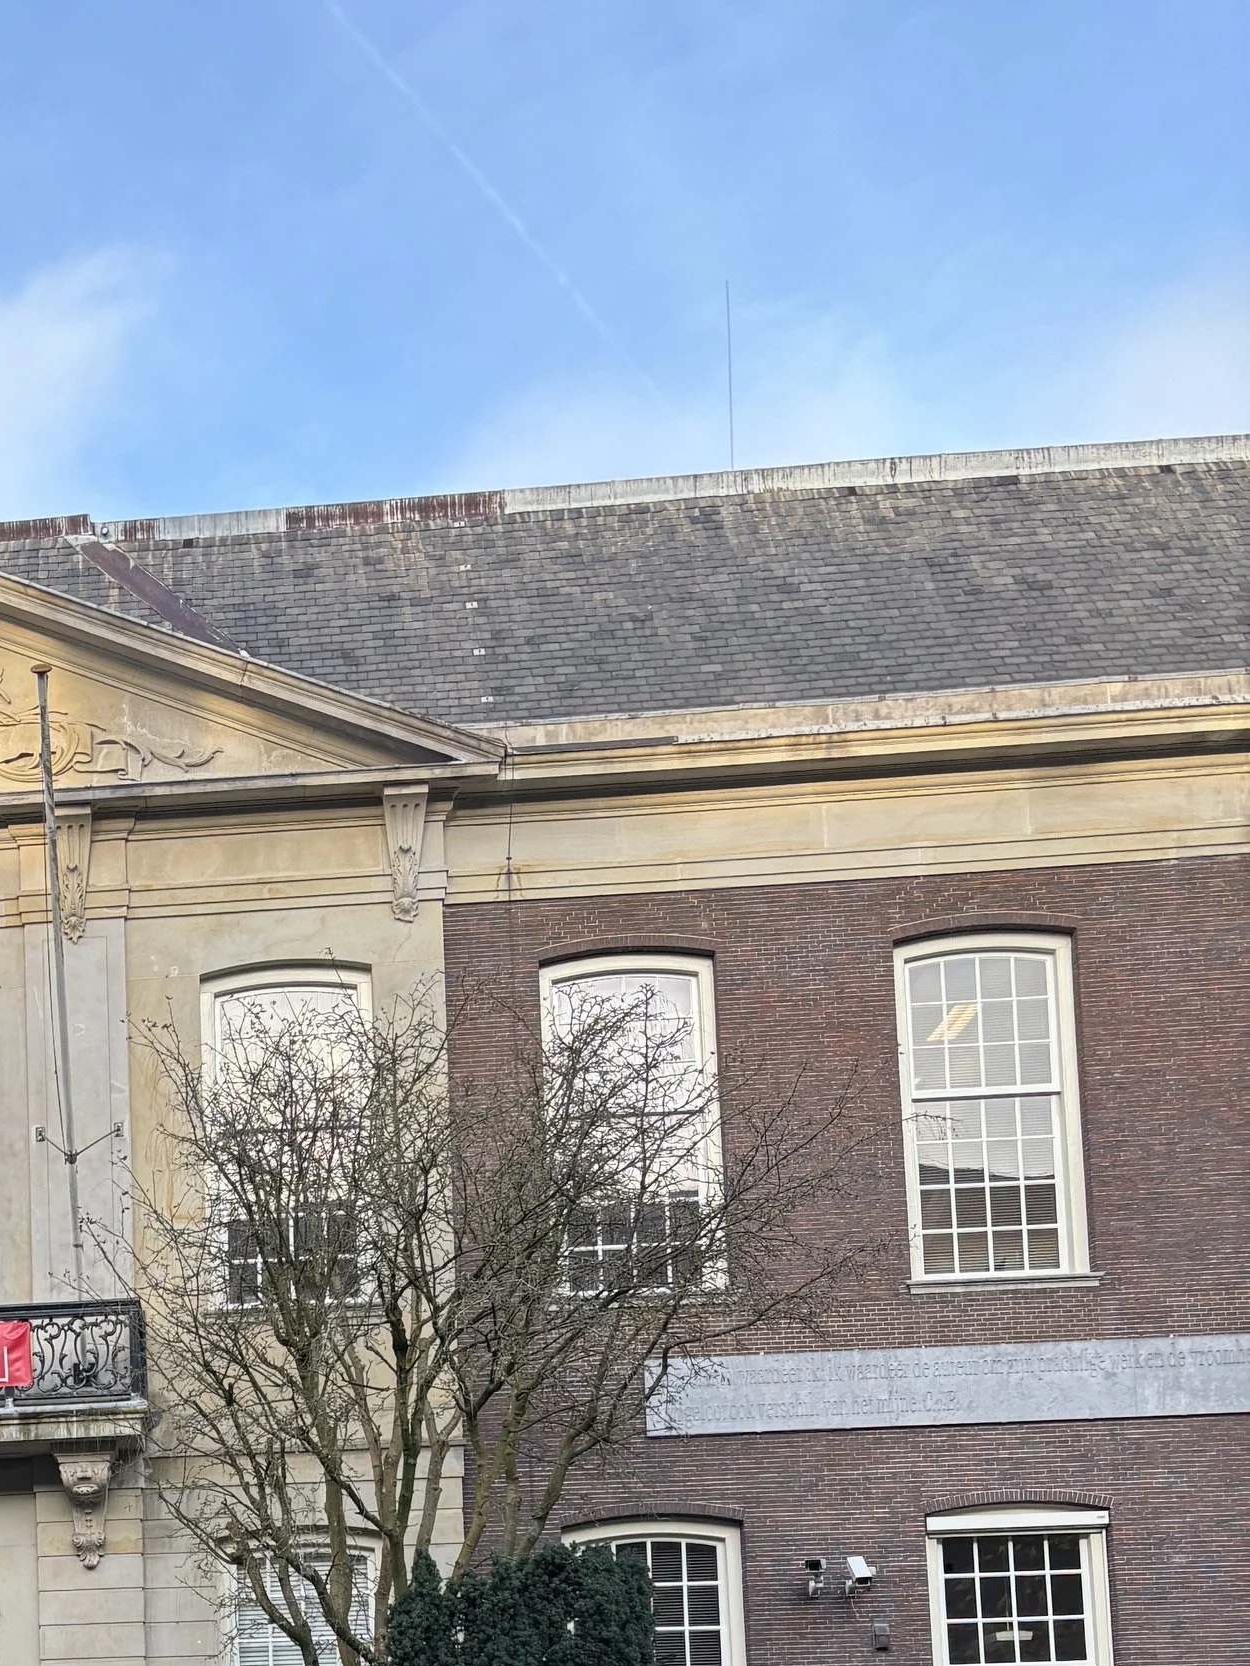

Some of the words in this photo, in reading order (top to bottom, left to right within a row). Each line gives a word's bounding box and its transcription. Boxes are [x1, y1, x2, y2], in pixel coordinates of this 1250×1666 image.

[845, 1353, 910, 1380] waardeer
[912, 1351, 930, 1378] de
[933, 1358, 978, 1377] auteur
[1108, 1343, 1144, 1370] werk
[1148, 1351, 1165, 1368] en
[1168, 1341, 1186, 1367] de
